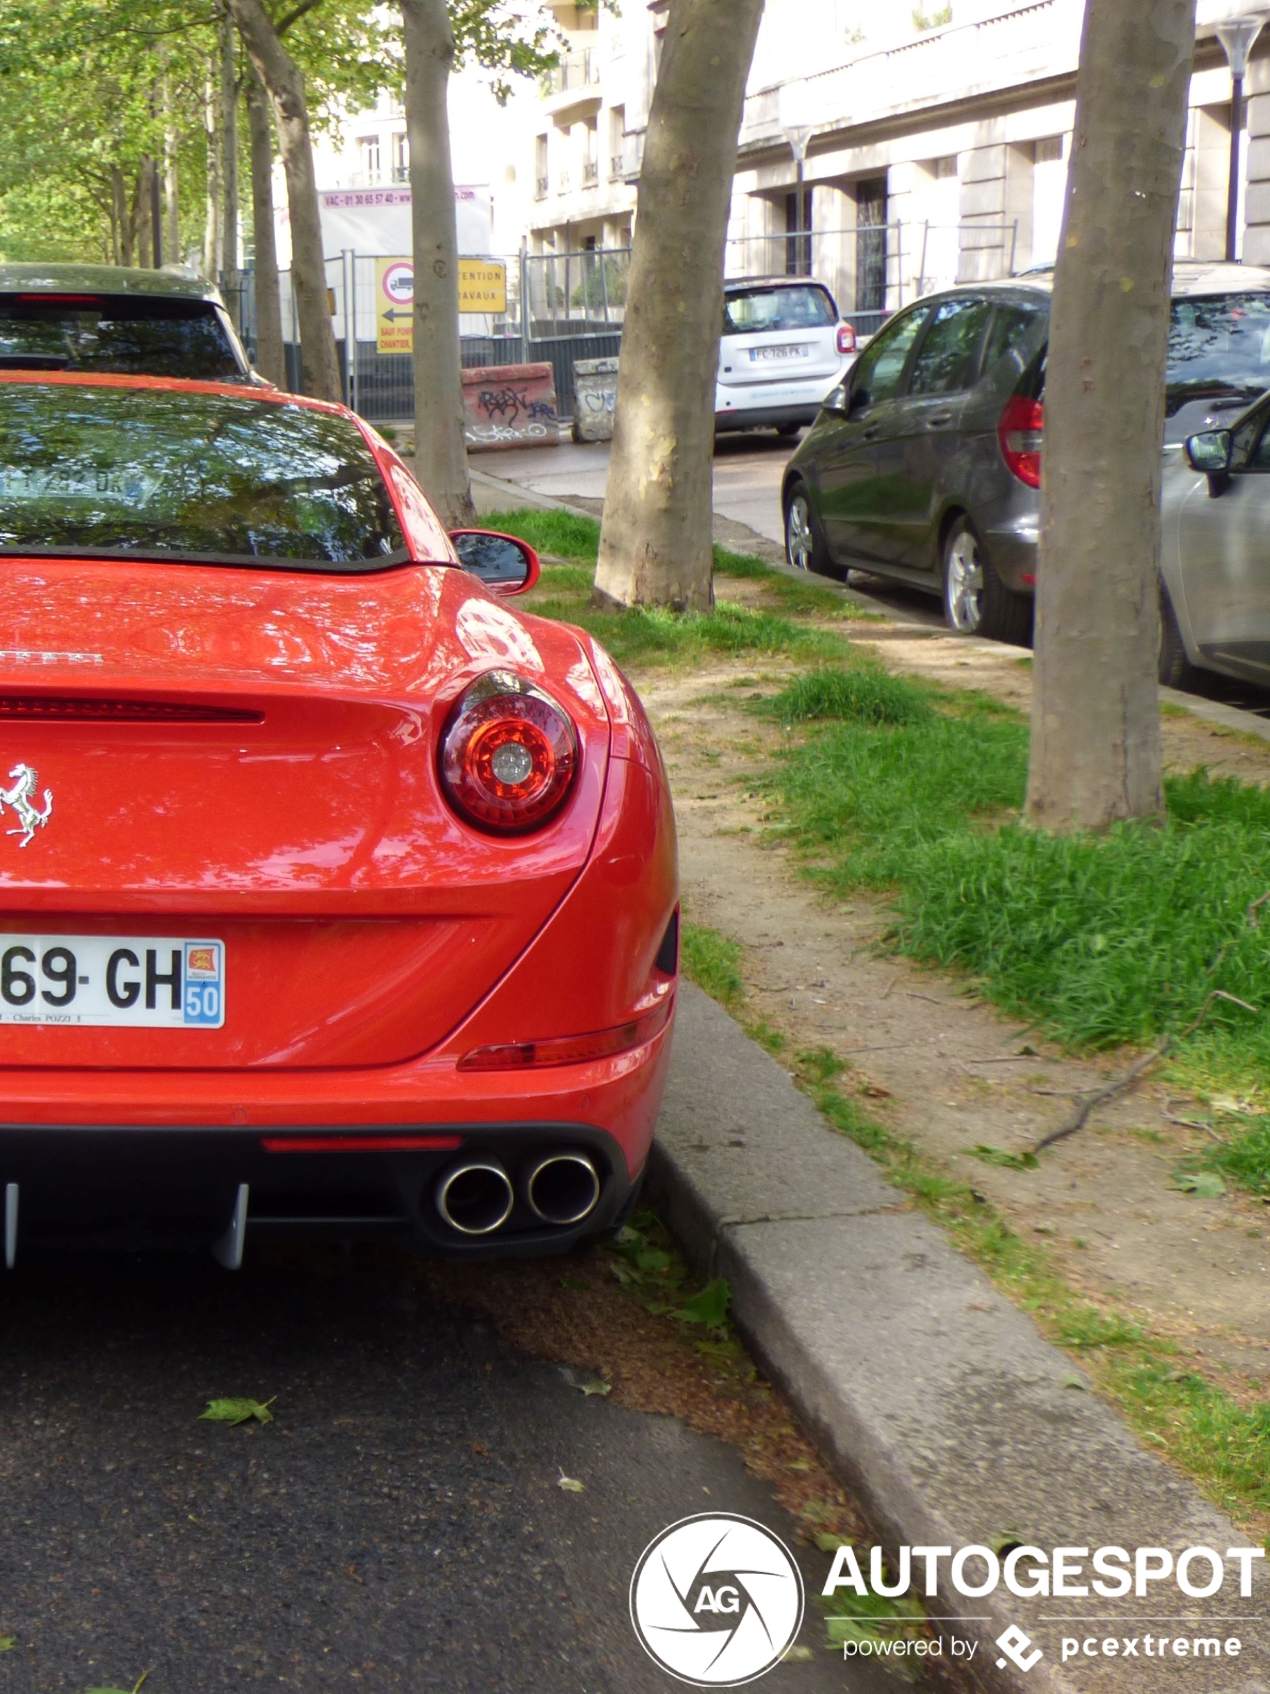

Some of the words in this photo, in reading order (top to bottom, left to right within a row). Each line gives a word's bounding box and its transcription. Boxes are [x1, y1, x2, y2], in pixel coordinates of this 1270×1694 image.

[325, 195, 339, 206] VAC
[345, 194, 353, 206] 01
[355, 194, 364, 205] 30
[375, 193, 384, 204] 57
[385, 193, 394, 203] 40
[458, 272, 501, 281] ENTION
[186, 987, 218, 1017] 50
[13, 1014, 42, 1022] Charles
[45, 1014, 71, 1023] POZZI
